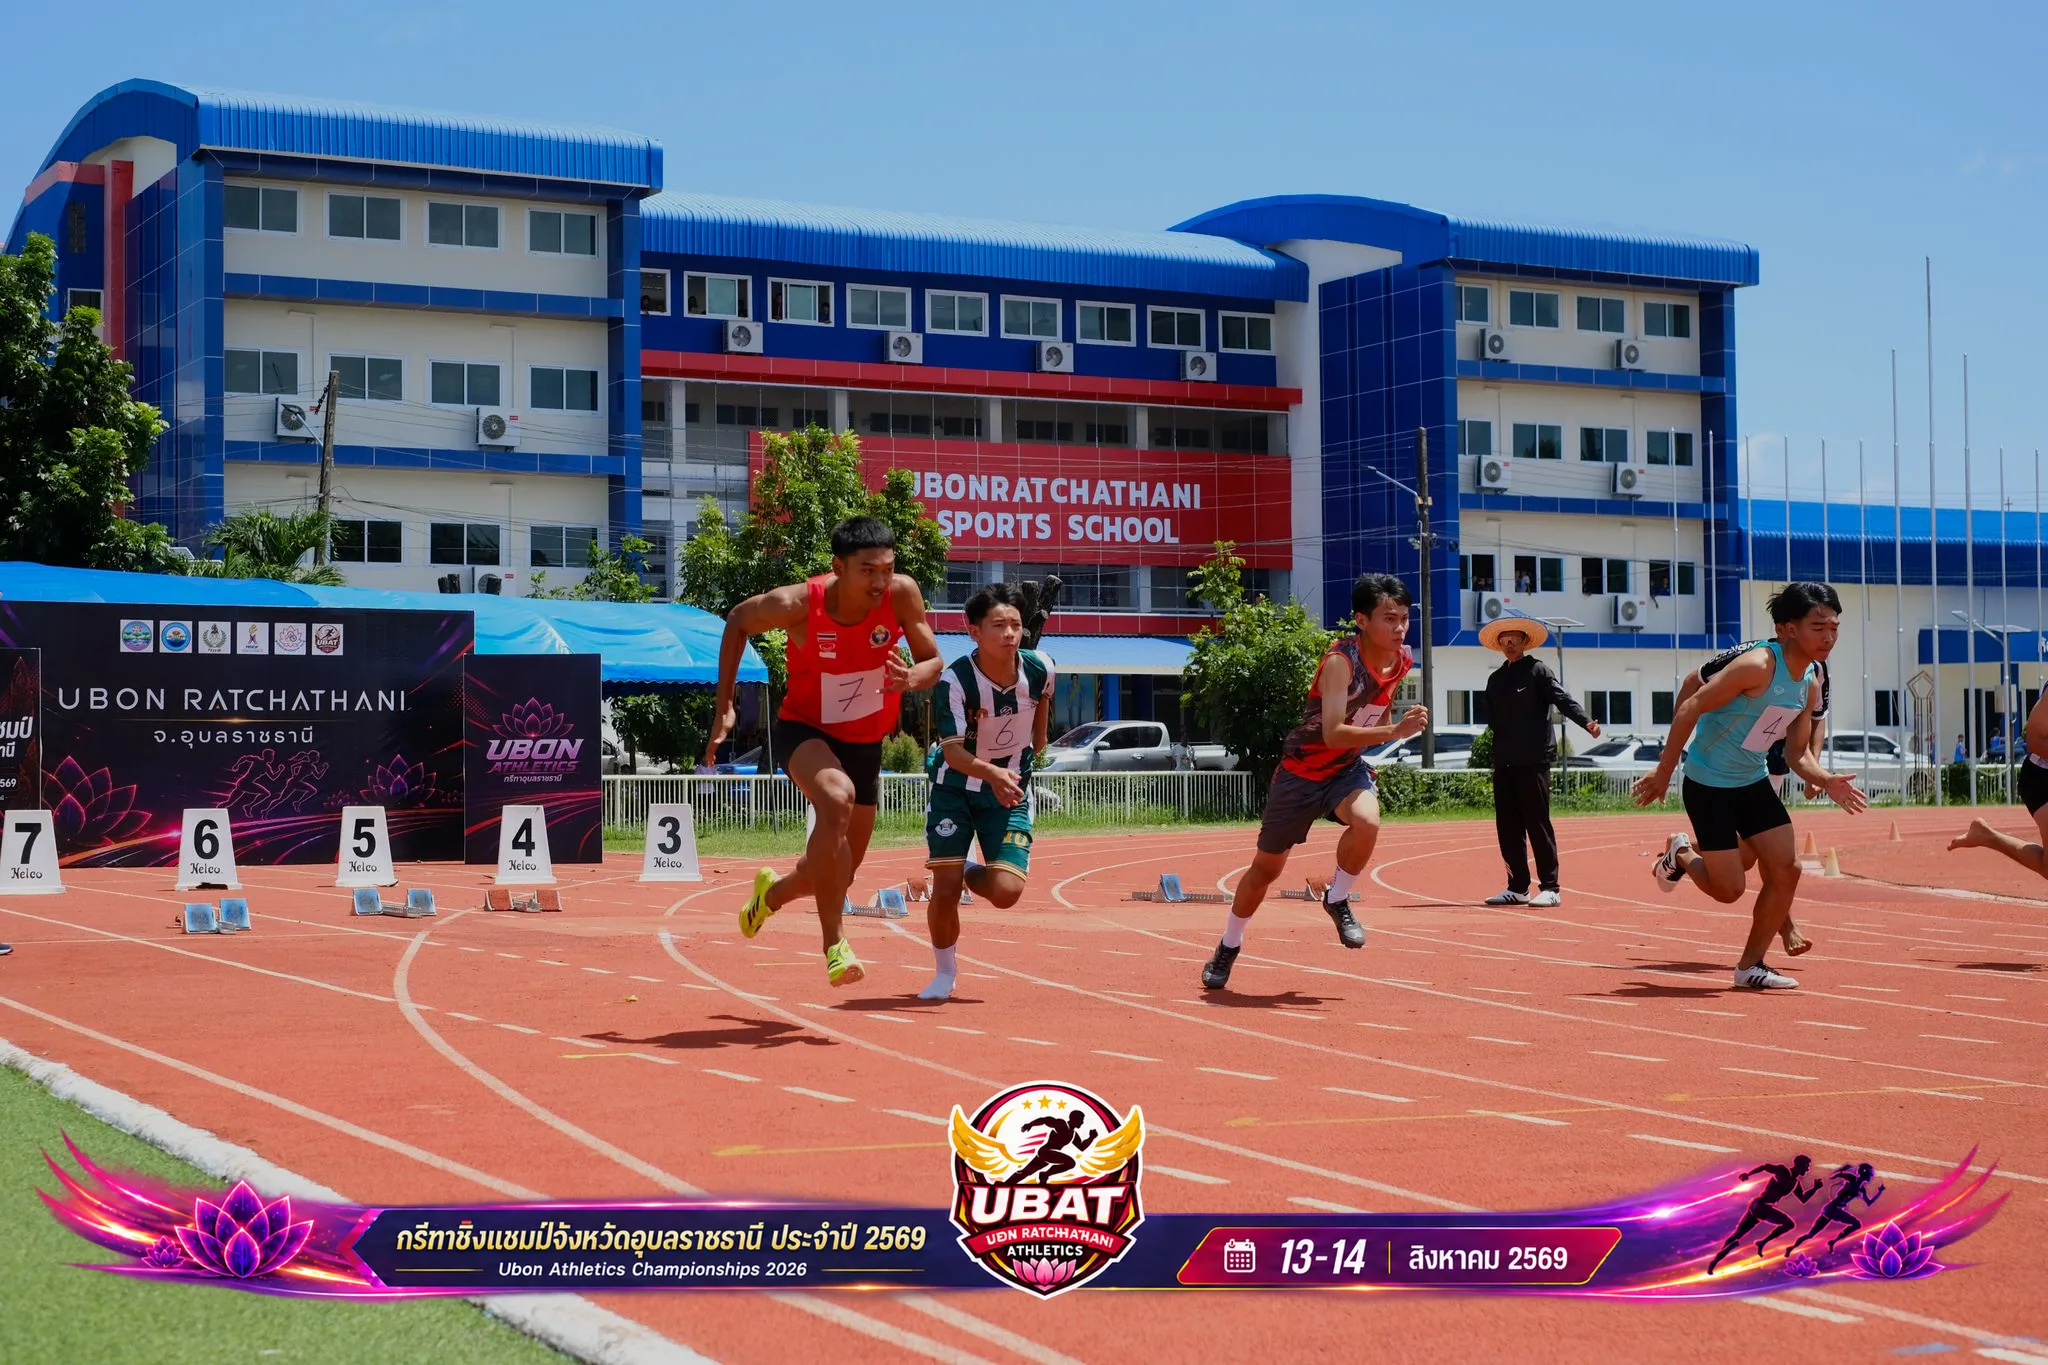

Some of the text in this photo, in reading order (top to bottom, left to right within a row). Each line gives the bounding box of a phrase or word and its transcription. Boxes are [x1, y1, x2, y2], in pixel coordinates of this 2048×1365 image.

[937, 509, 1180, 544] SPORTS SCHOOL
[58, 687, 406, 712] UBON RATCHATHANI
[838, 677, 864, 713] 7
[153, 725, 314, 749] จ.อุบลราชธานี
[995, 718, 1014, 746] 6
[1762, 715, 1783, 745] 4
[486, 738, 585, 760] UBON
[489, 760, 581, 774] ATHLETICS
[14, 822, 42, 865] 7
[193, 819, 220, 860] 6
[352, 818, 376, 858] 5
[511, 818, 536, 857] 4
[657, 815, 682, 855] 3
[10, 867, 43, 879] Nelco
[190, 862, 222, 875] Nelco
[349, 860, 378, 872] Nelco
[508, 859, 537, 871] Nelco
[653, 856, 683, 869] Nelco
